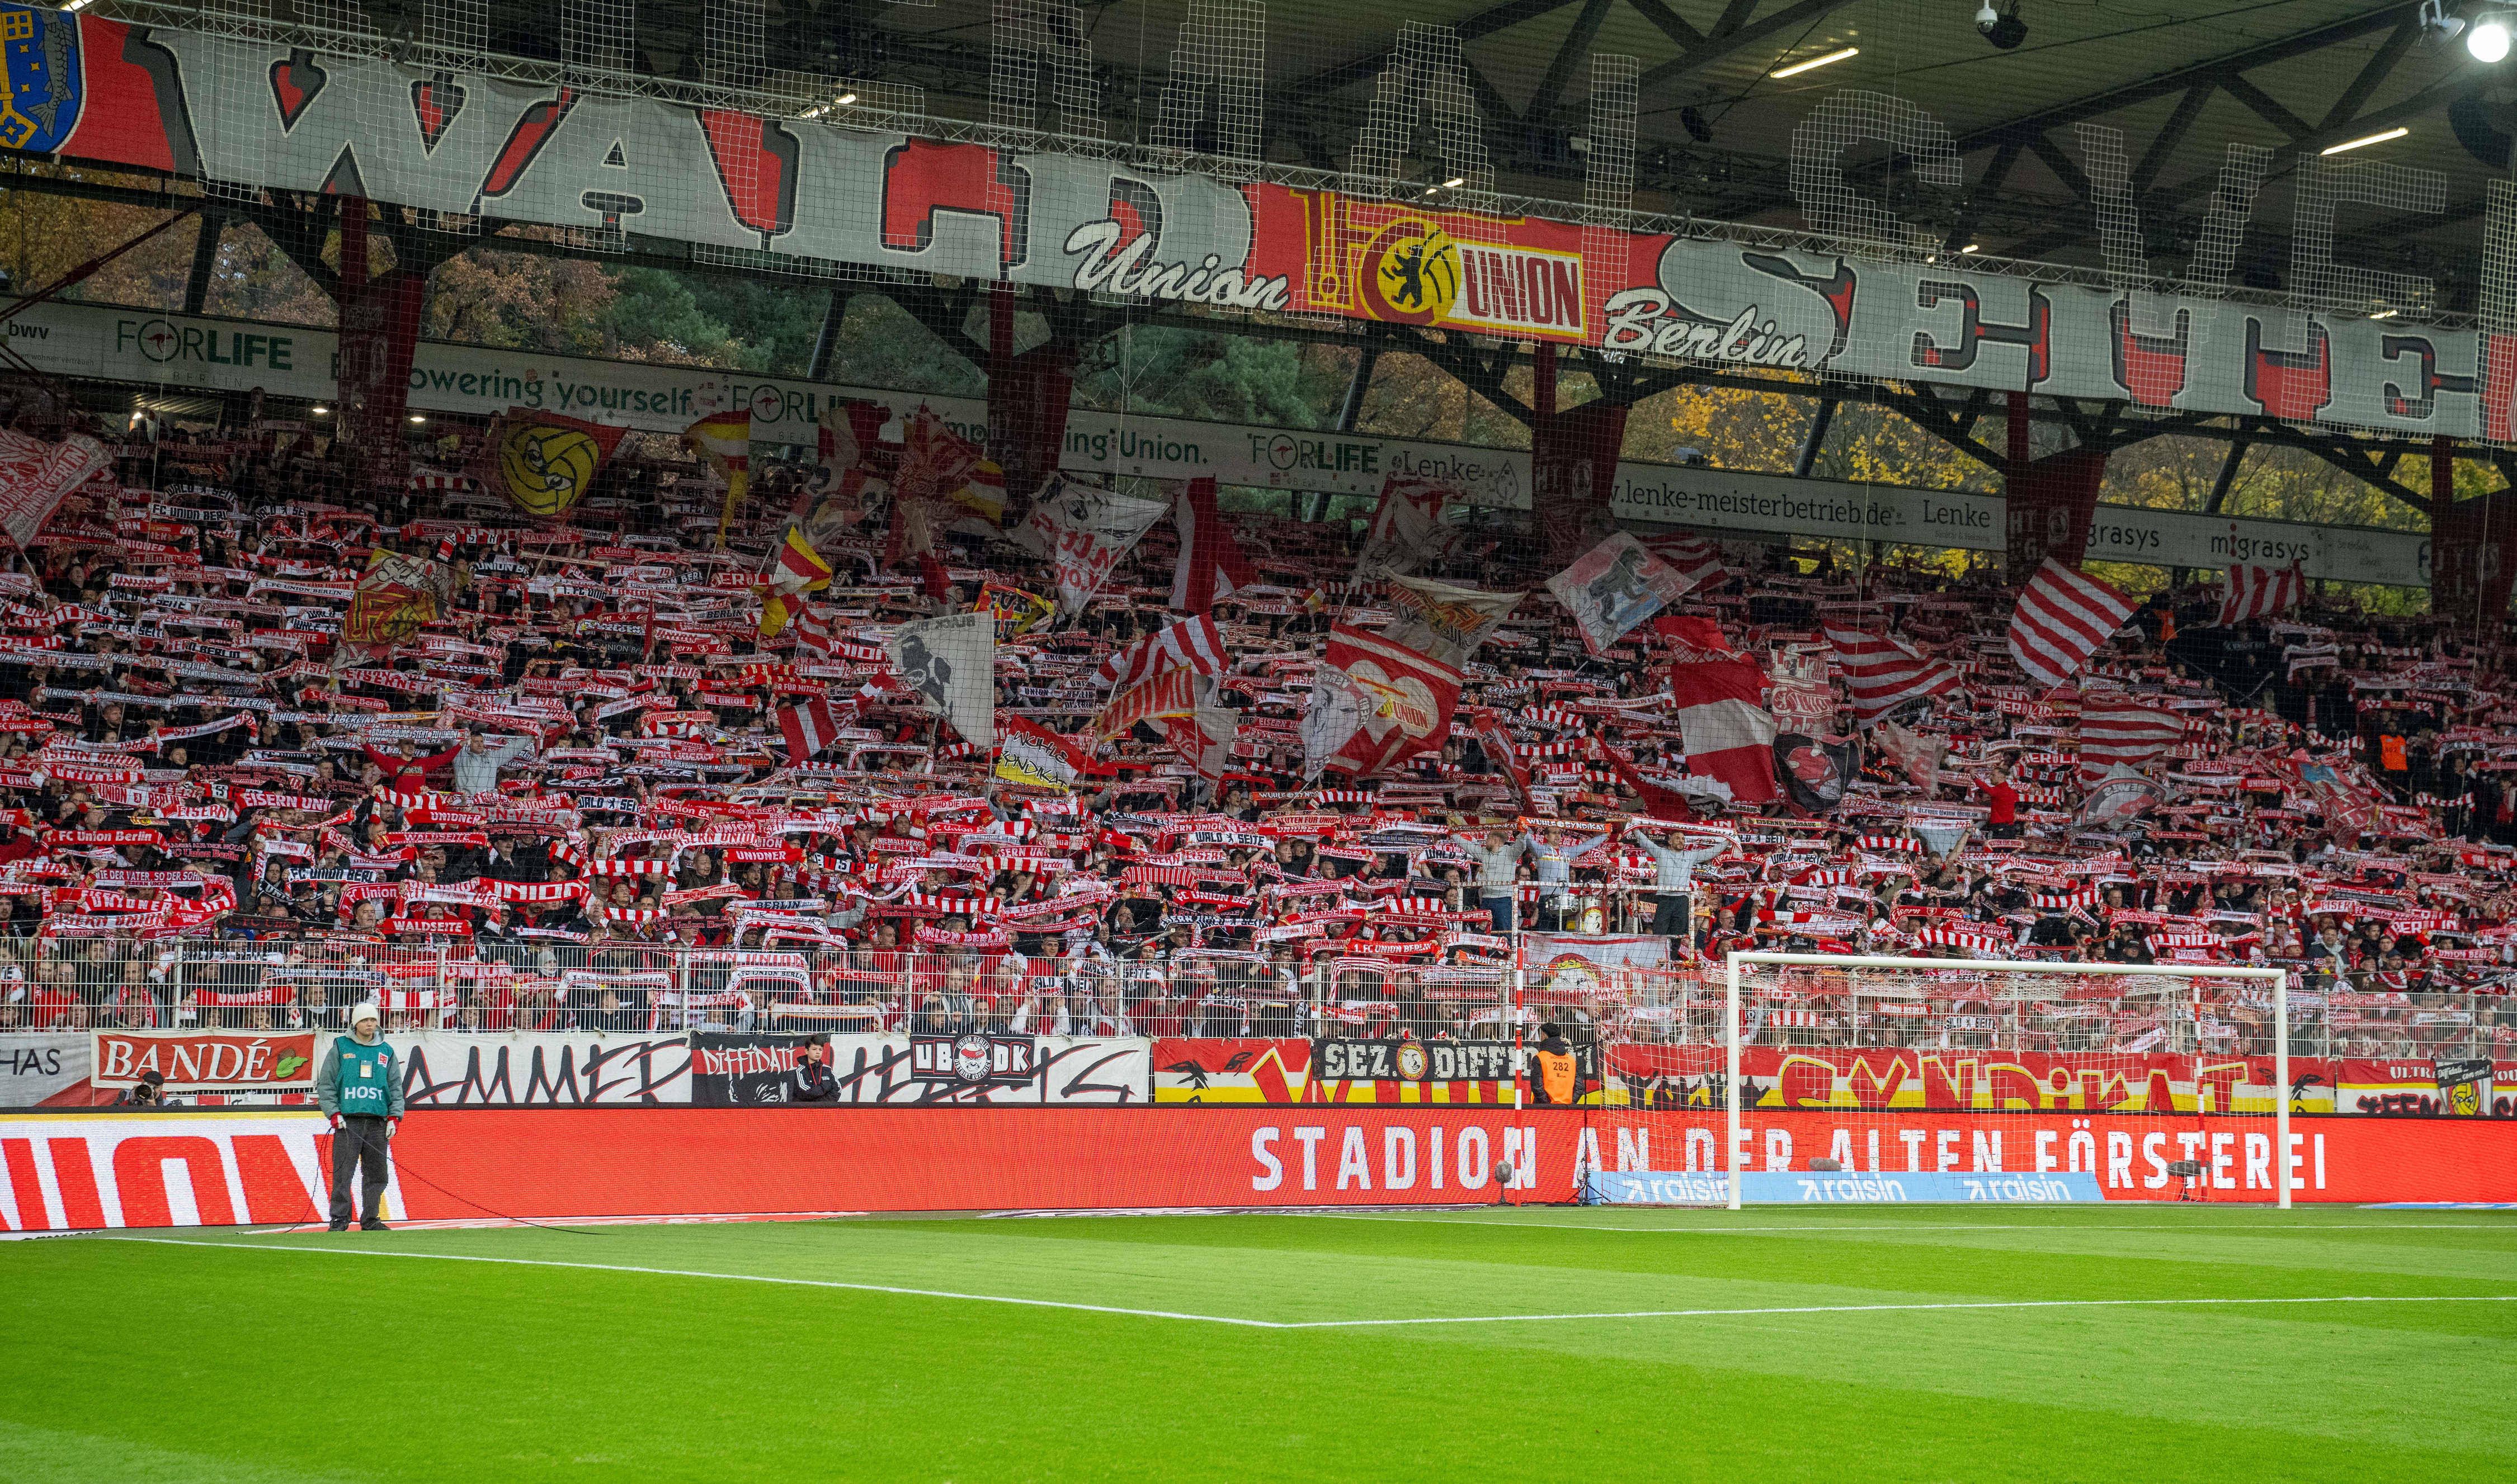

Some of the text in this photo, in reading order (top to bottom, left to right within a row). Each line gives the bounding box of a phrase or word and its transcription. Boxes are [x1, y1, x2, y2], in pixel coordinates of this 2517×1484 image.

[148, 28, 1254, 313] WALD
[1063, 220, 1289, 312] Union
[1463, 246, 1582, 329] UNION
[8, 319, 50, 339] bwv
[1604, 288, 1808, 368] Berlin
[117, 319, 292, 370] FORLIFE
[1658, 238, 2479, 439] SEITE
[31, 354, 59, 363] wohnen
[62, 357, 95, 366] vertrauen
[173, 373, 243, 387] BERLIN
[557, 383, 700, 418] yourself.
[1120, 431, 1207, 464] Union.
[1253, 434, 1379, 474] FORLIFE
[1404, 451, 1480, 482] Lenke
[167, 483, 194, 497] WALD
[153, 504, 200, 519] FC UNION
[1923, 499, 1990, 527] Lenke
[522, 534, 572, 543] WALDSEITE
[2087, 524, 2160, 549] grasys
[2211, 522, 2309, 561] migrasys
[478, 561, 517, 571] UNION
[285, 583, 311, 593] UNION
[109, 589, 186, 610] WALD SEITE
[990, 593, 1030, 614] FÜR
[707, 608, 744, 619] BERLIN
[200, 644, 241, 659] BERLIN
[45, 688, 74, 698] UNION
[783, 683, 796, 692] FÜR
[1024, 687, 1049, 697] UNION
[173, 694, 201, 706] UNION
[333, 695, 384, 708] Union Berlin
[272, 713, 303, 722] UNION
[1392, 700, 1429, 730] UNION
[119, 741, 148, 753] 1966
[1014, 730, 1068, 765] WUHLE
[1233, 743, 1257, 757] UNION
[56, 769, 124, 782] UNIONER
[1001, 750, 1068, 792] SYNDIKAT
[2246, 779, 2282, 788] UNIONER
[98, 784, 183, 808] UNION BERLIN
[244, 793, 298, 807] EISERN
[836, 795, 871, 804] WUHLE
[517, 797, 562, 811] UNIONER
[663, 803, 695, 815] Union
[177, 805, 229, 820] EISERN
[430, 811, 481, 826] UNIONER
[715, 821, 756, 833] UNION
[1528, 817, 1605, 831] WUHLE SYNDIKAT
[59, 829, 153, 842] FC Union Berlin
[404, 833, 471, 842] WALDSEITE
[1195, 831, 1265, 845] WALD SEITE
[736, 850, 786, 862] UNIONER
[1321, 845, 1362, 855] UNION
[1425, 849, 1457, 861] WALD
[1771, 853, 1794, 864] WALD
[110, 869, 124, 880] DER
[155, 871, 167, 881] SO
[169, 872, 183, 882] DER
[291, 868, 343, 881] FC UNION
[347, 886, 397, 902] FC Union
[1176, 890, 1229, 902] FC UNION
[93, 895, 172, 912] UNIONER
[756, 900, 800, 910] BERLIN
[1045, 899, 1074, 910] Union
[1298, 909, 1353, 920] WALDSEITE
[1385, 915, 1420, 924] UNION
[1892, 907, 1921, 920] Eisern
[393, 920, 463, 933] WALDSEITE
[1302, 924, 1324, 935] 1966
[2394, 919, 2460, 935] BERLIN
[918, 927, 1008, 945] UNION BERLIN
[1363, 942, 1432, 954] FC UNION BERLIN
[958, 1037, 989, 1050] UNION BERLIN
[102, 1040, 272, 1081] BANDÉ
[916, 1042, 1029, 1072] UB DK
[1326, 1044, 1397, 1077] SEZ.
[402, 1038, 692, 1103] AMMER
[954, 1058, 972, 1079] DISTRIKT
[1553, 1062, 1569, 1071] 282
[345, 1086, 383, 1100] HOST
[1252, 1126, 1536, 1191] STADION
[1573, 1127, 1649, 1188] AN
[2036, 1119, 2325, 1190] FÖRSTEREI
[1823, 1171, 1905, 1202] raisin
[1989, 1171, 2070, 1202] raisin
